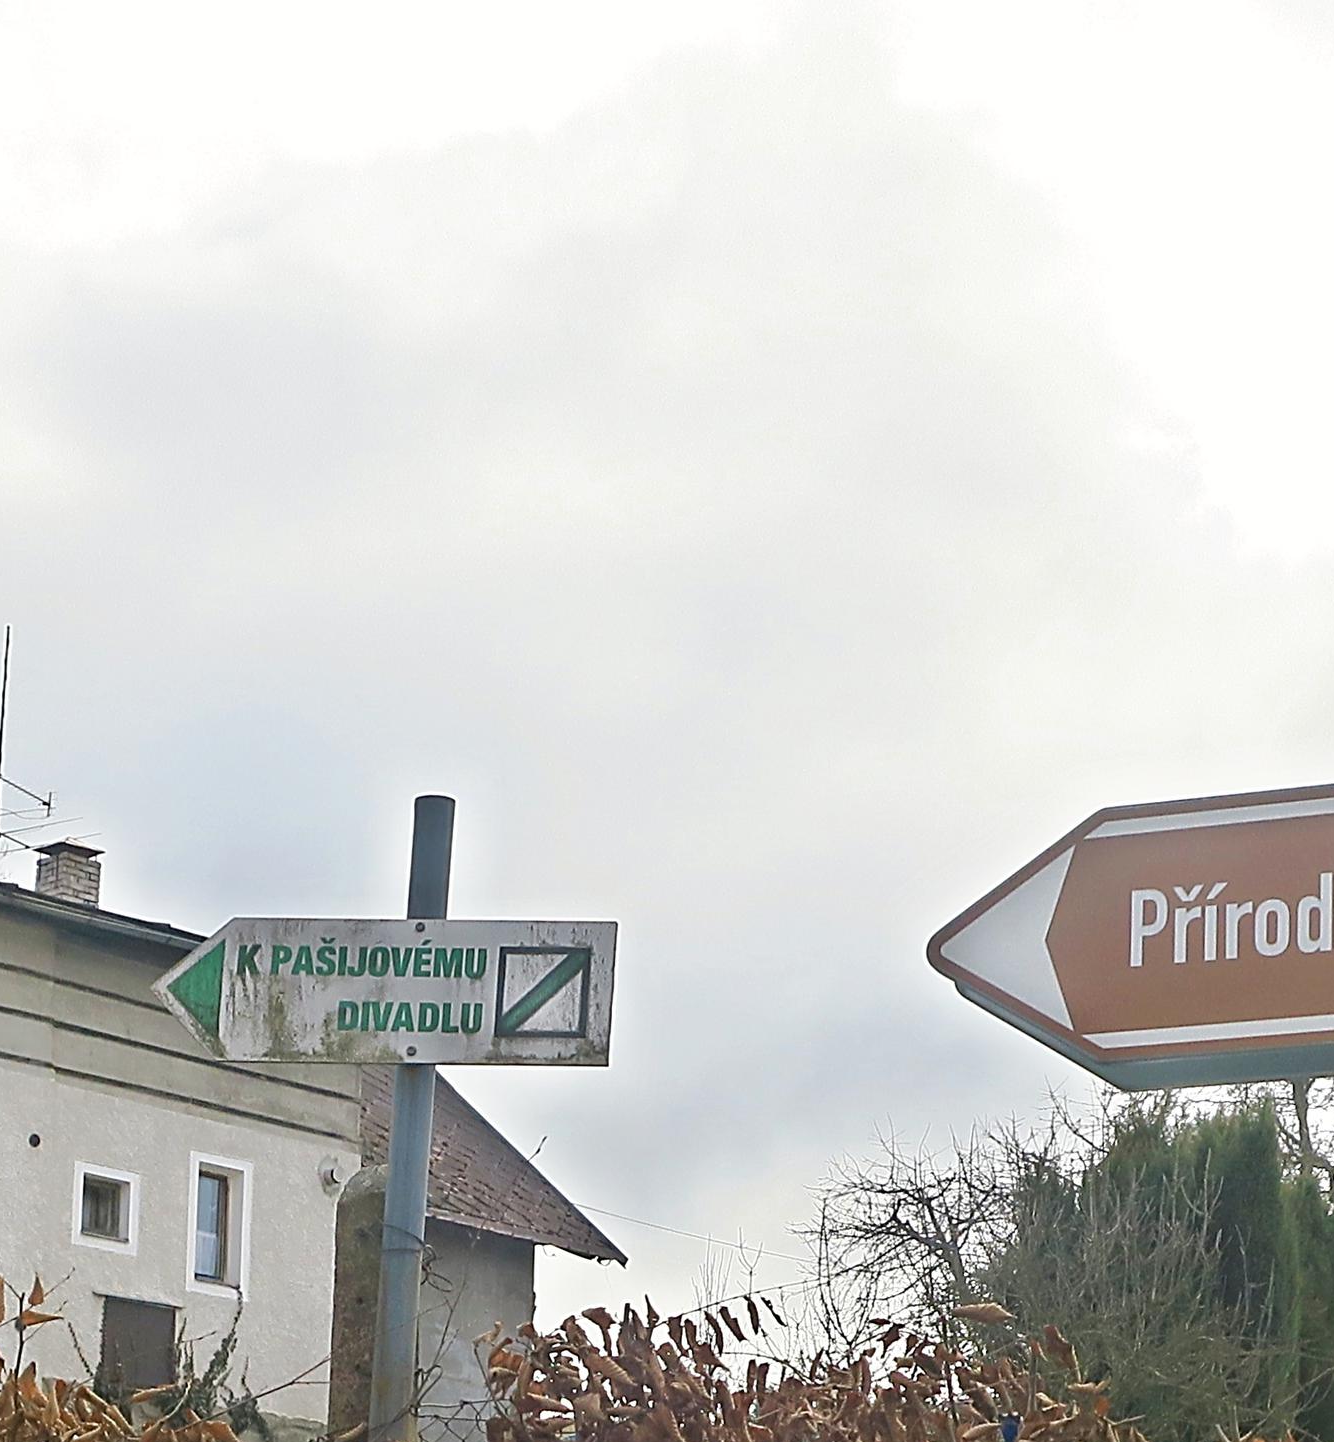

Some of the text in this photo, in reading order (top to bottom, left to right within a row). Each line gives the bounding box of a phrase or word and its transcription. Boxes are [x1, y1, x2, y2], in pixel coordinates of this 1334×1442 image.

[235, 938, 487, 980] K PAŠIJOVÉMU
[336, 1002, 483, 1035] DIVADLU
